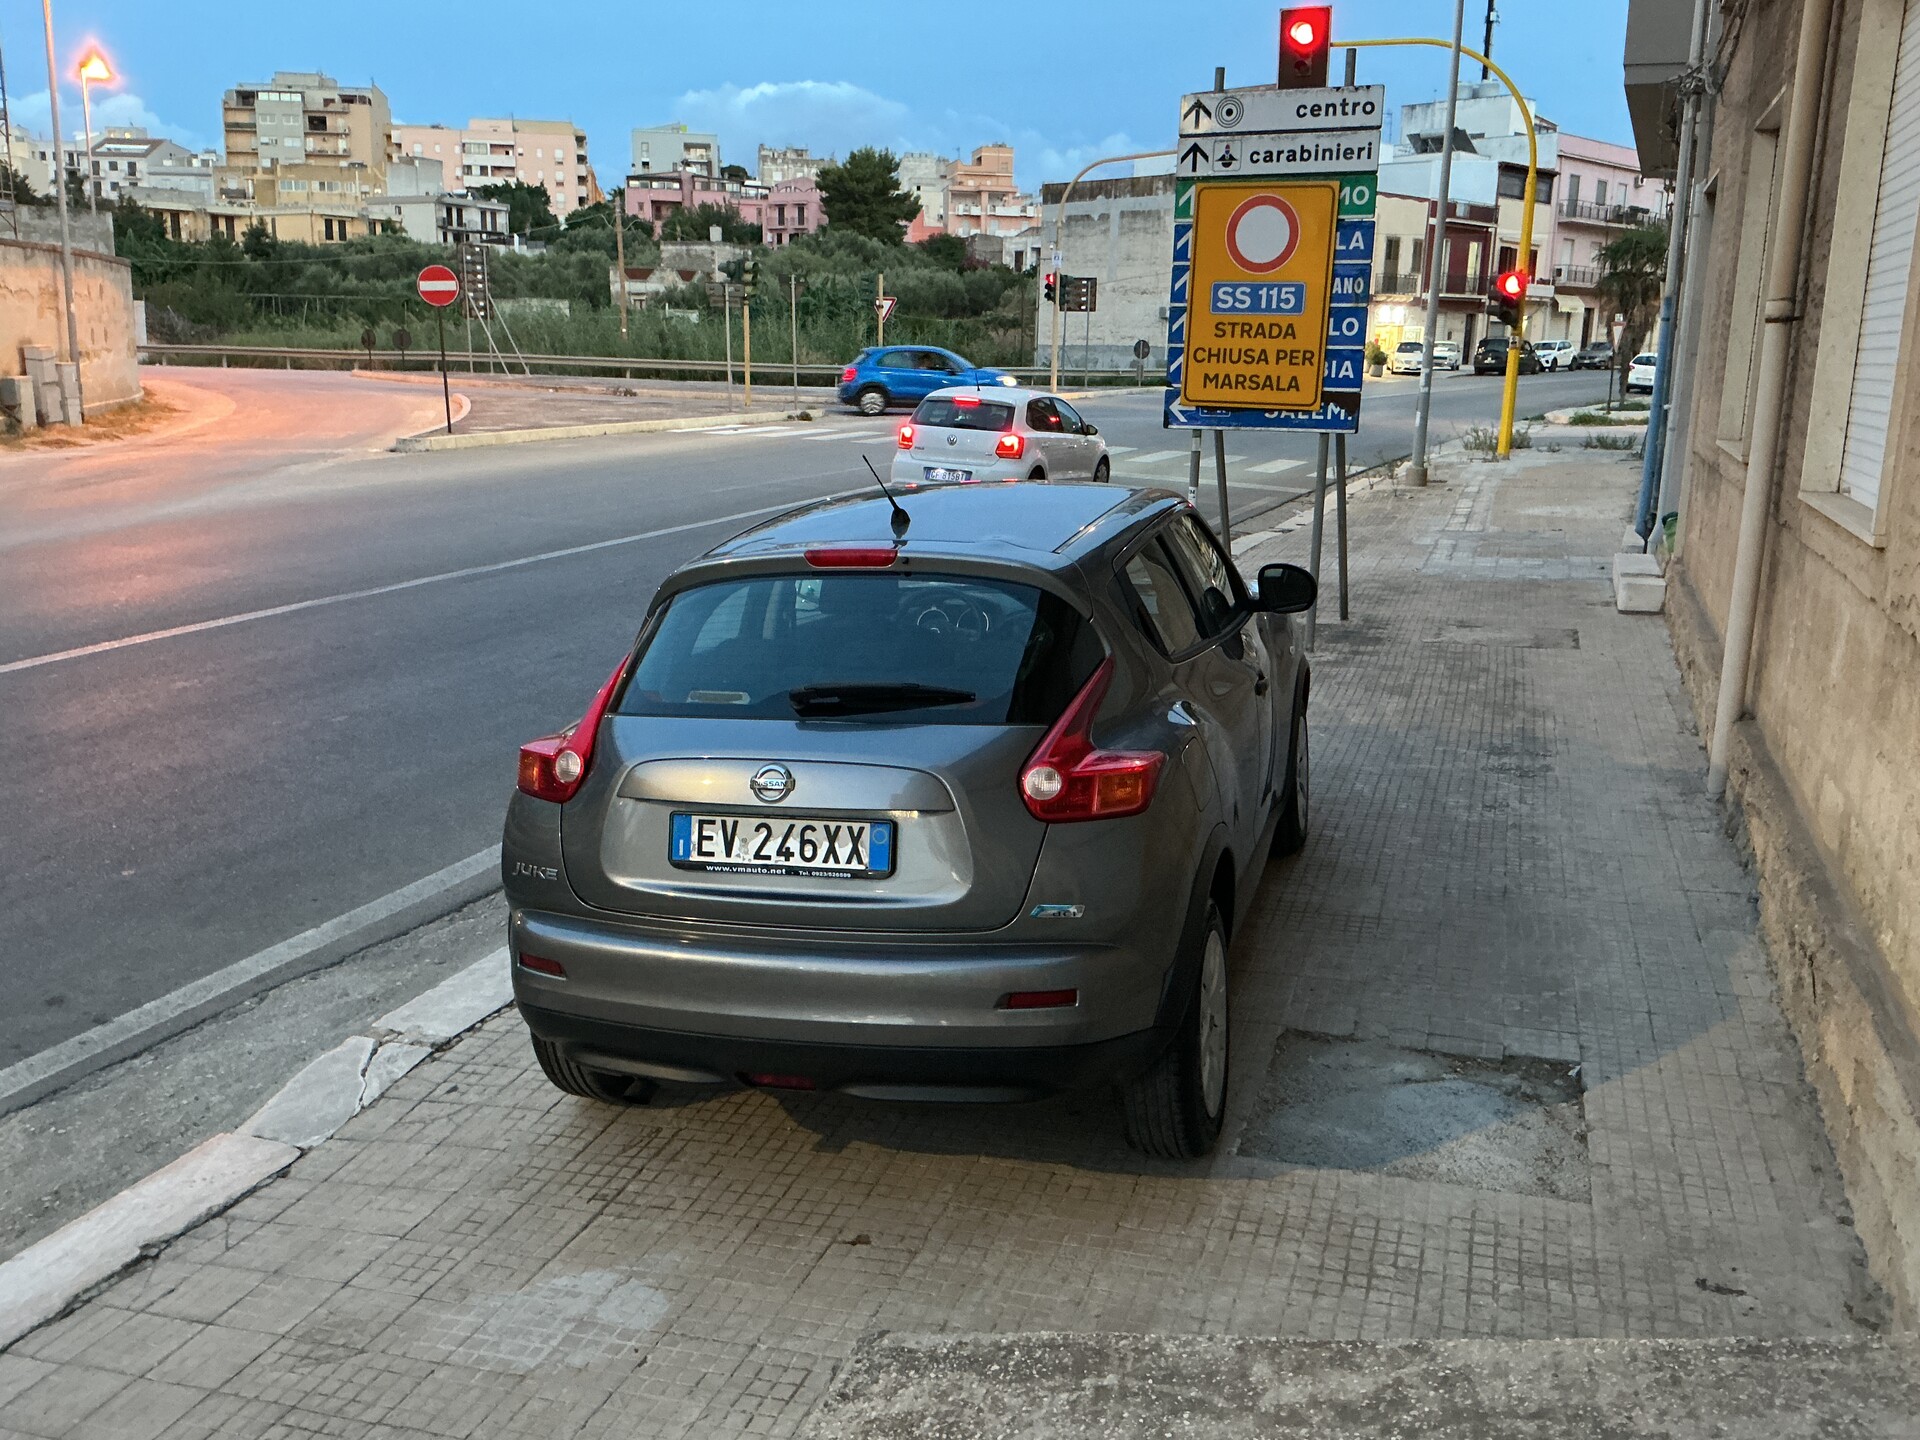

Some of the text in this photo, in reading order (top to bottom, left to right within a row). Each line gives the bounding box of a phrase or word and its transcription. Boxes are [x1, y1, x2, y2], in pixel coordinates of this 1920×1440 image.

[1296, 98, 1376, 118] centro
[1250, 142, 1373, 164] carabinieri
[1216, 287, 1296, 310] SS 115
[1214, 322, 1297, 340] STRADA
[1193, 347, 1315, 367] CHIUSA PER
[1203, 373, 1300, 392] MARSALA
[697, 819, 739, 858] EV
[753, 822, 866, 865] 246XX
[512, 862, 559, 881] JUKE
[706, 865, 786, 875] www.vmauto.net
